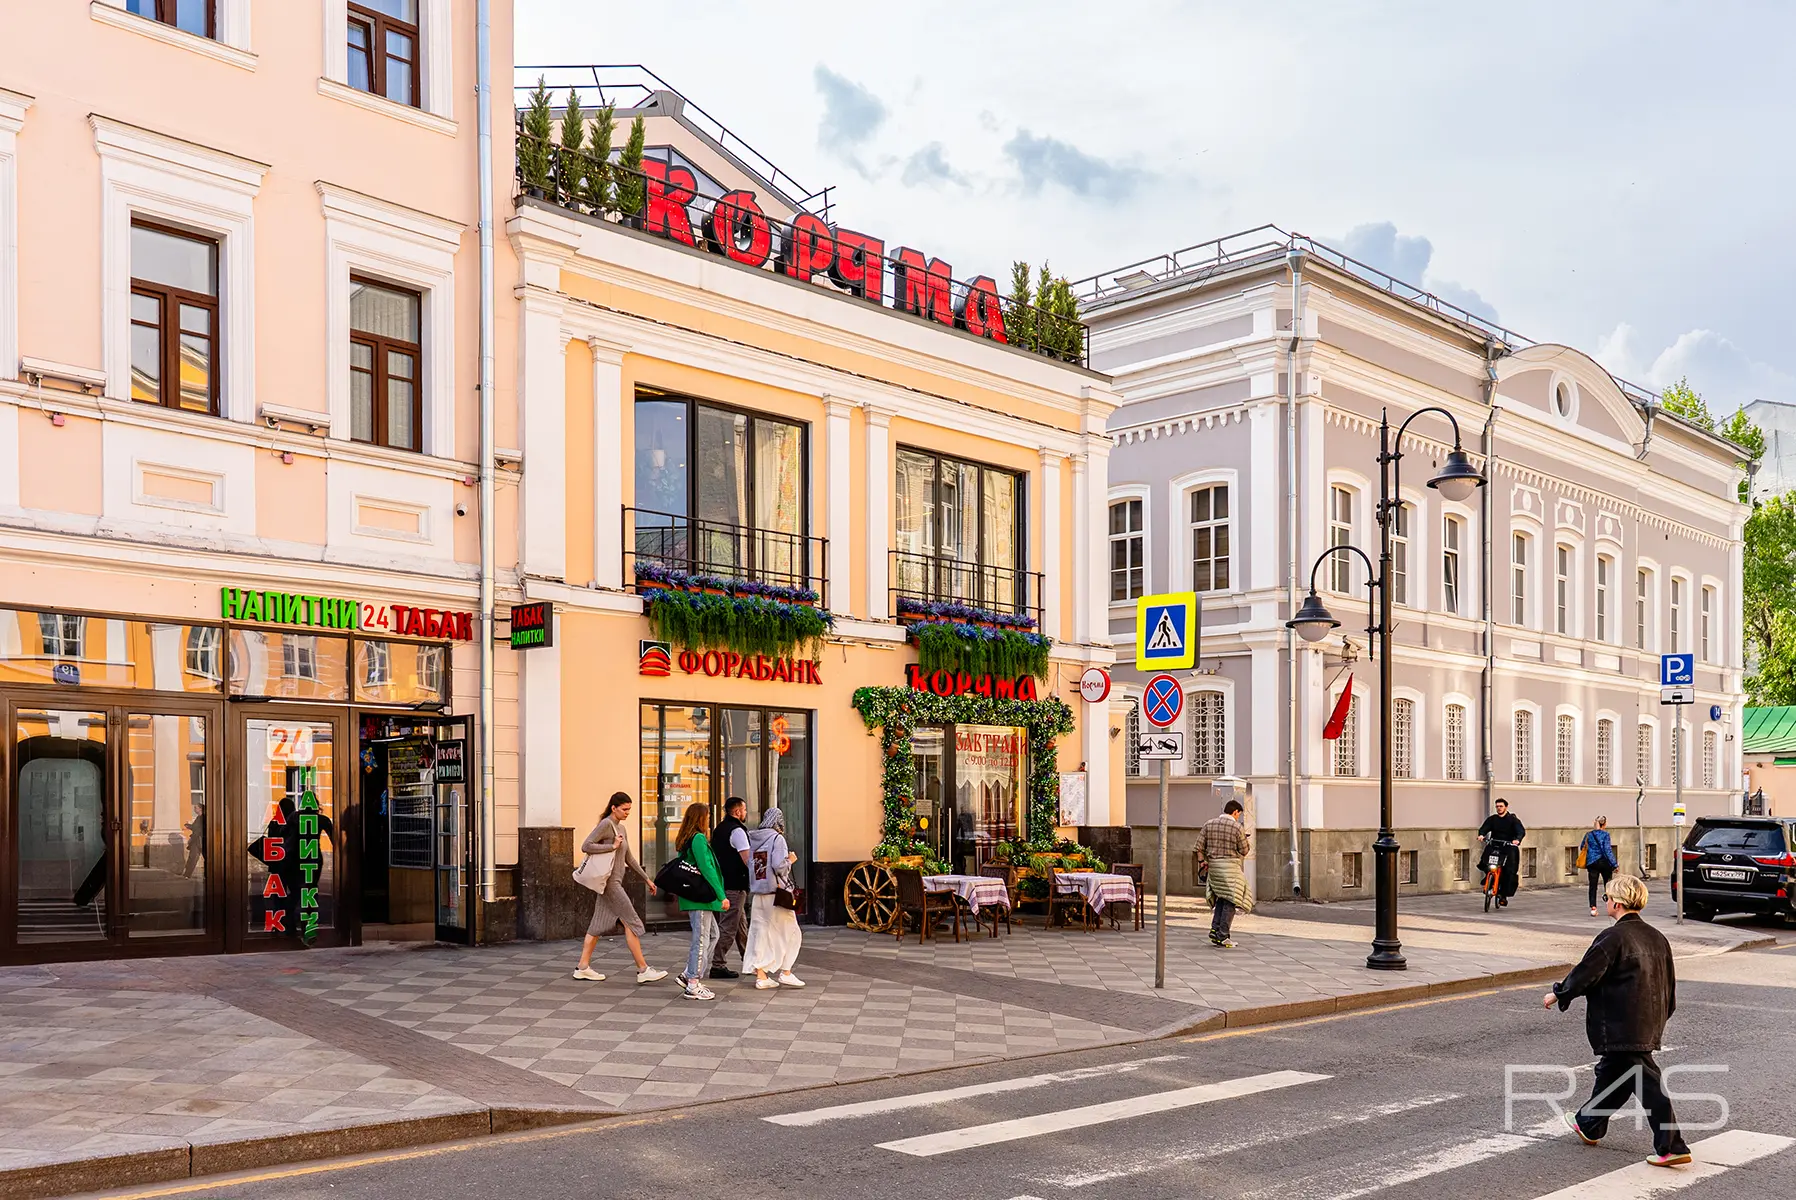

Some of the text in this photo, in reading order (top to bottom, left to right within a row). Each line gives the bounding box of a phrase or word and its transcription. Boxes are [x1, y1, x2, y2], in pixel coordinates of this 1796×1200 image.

[221, 587, 473, 641] НАПИТКИ 24 ТАБАК
[512, 605, 544, 627] ТАБАК
[511, 629, 545, 646] НАПИТКИ
[678, 649, 823, 685] ФОРАБАНК
[1666, 657, 1685, 683] P
[272, 729, 308, 757] 24
